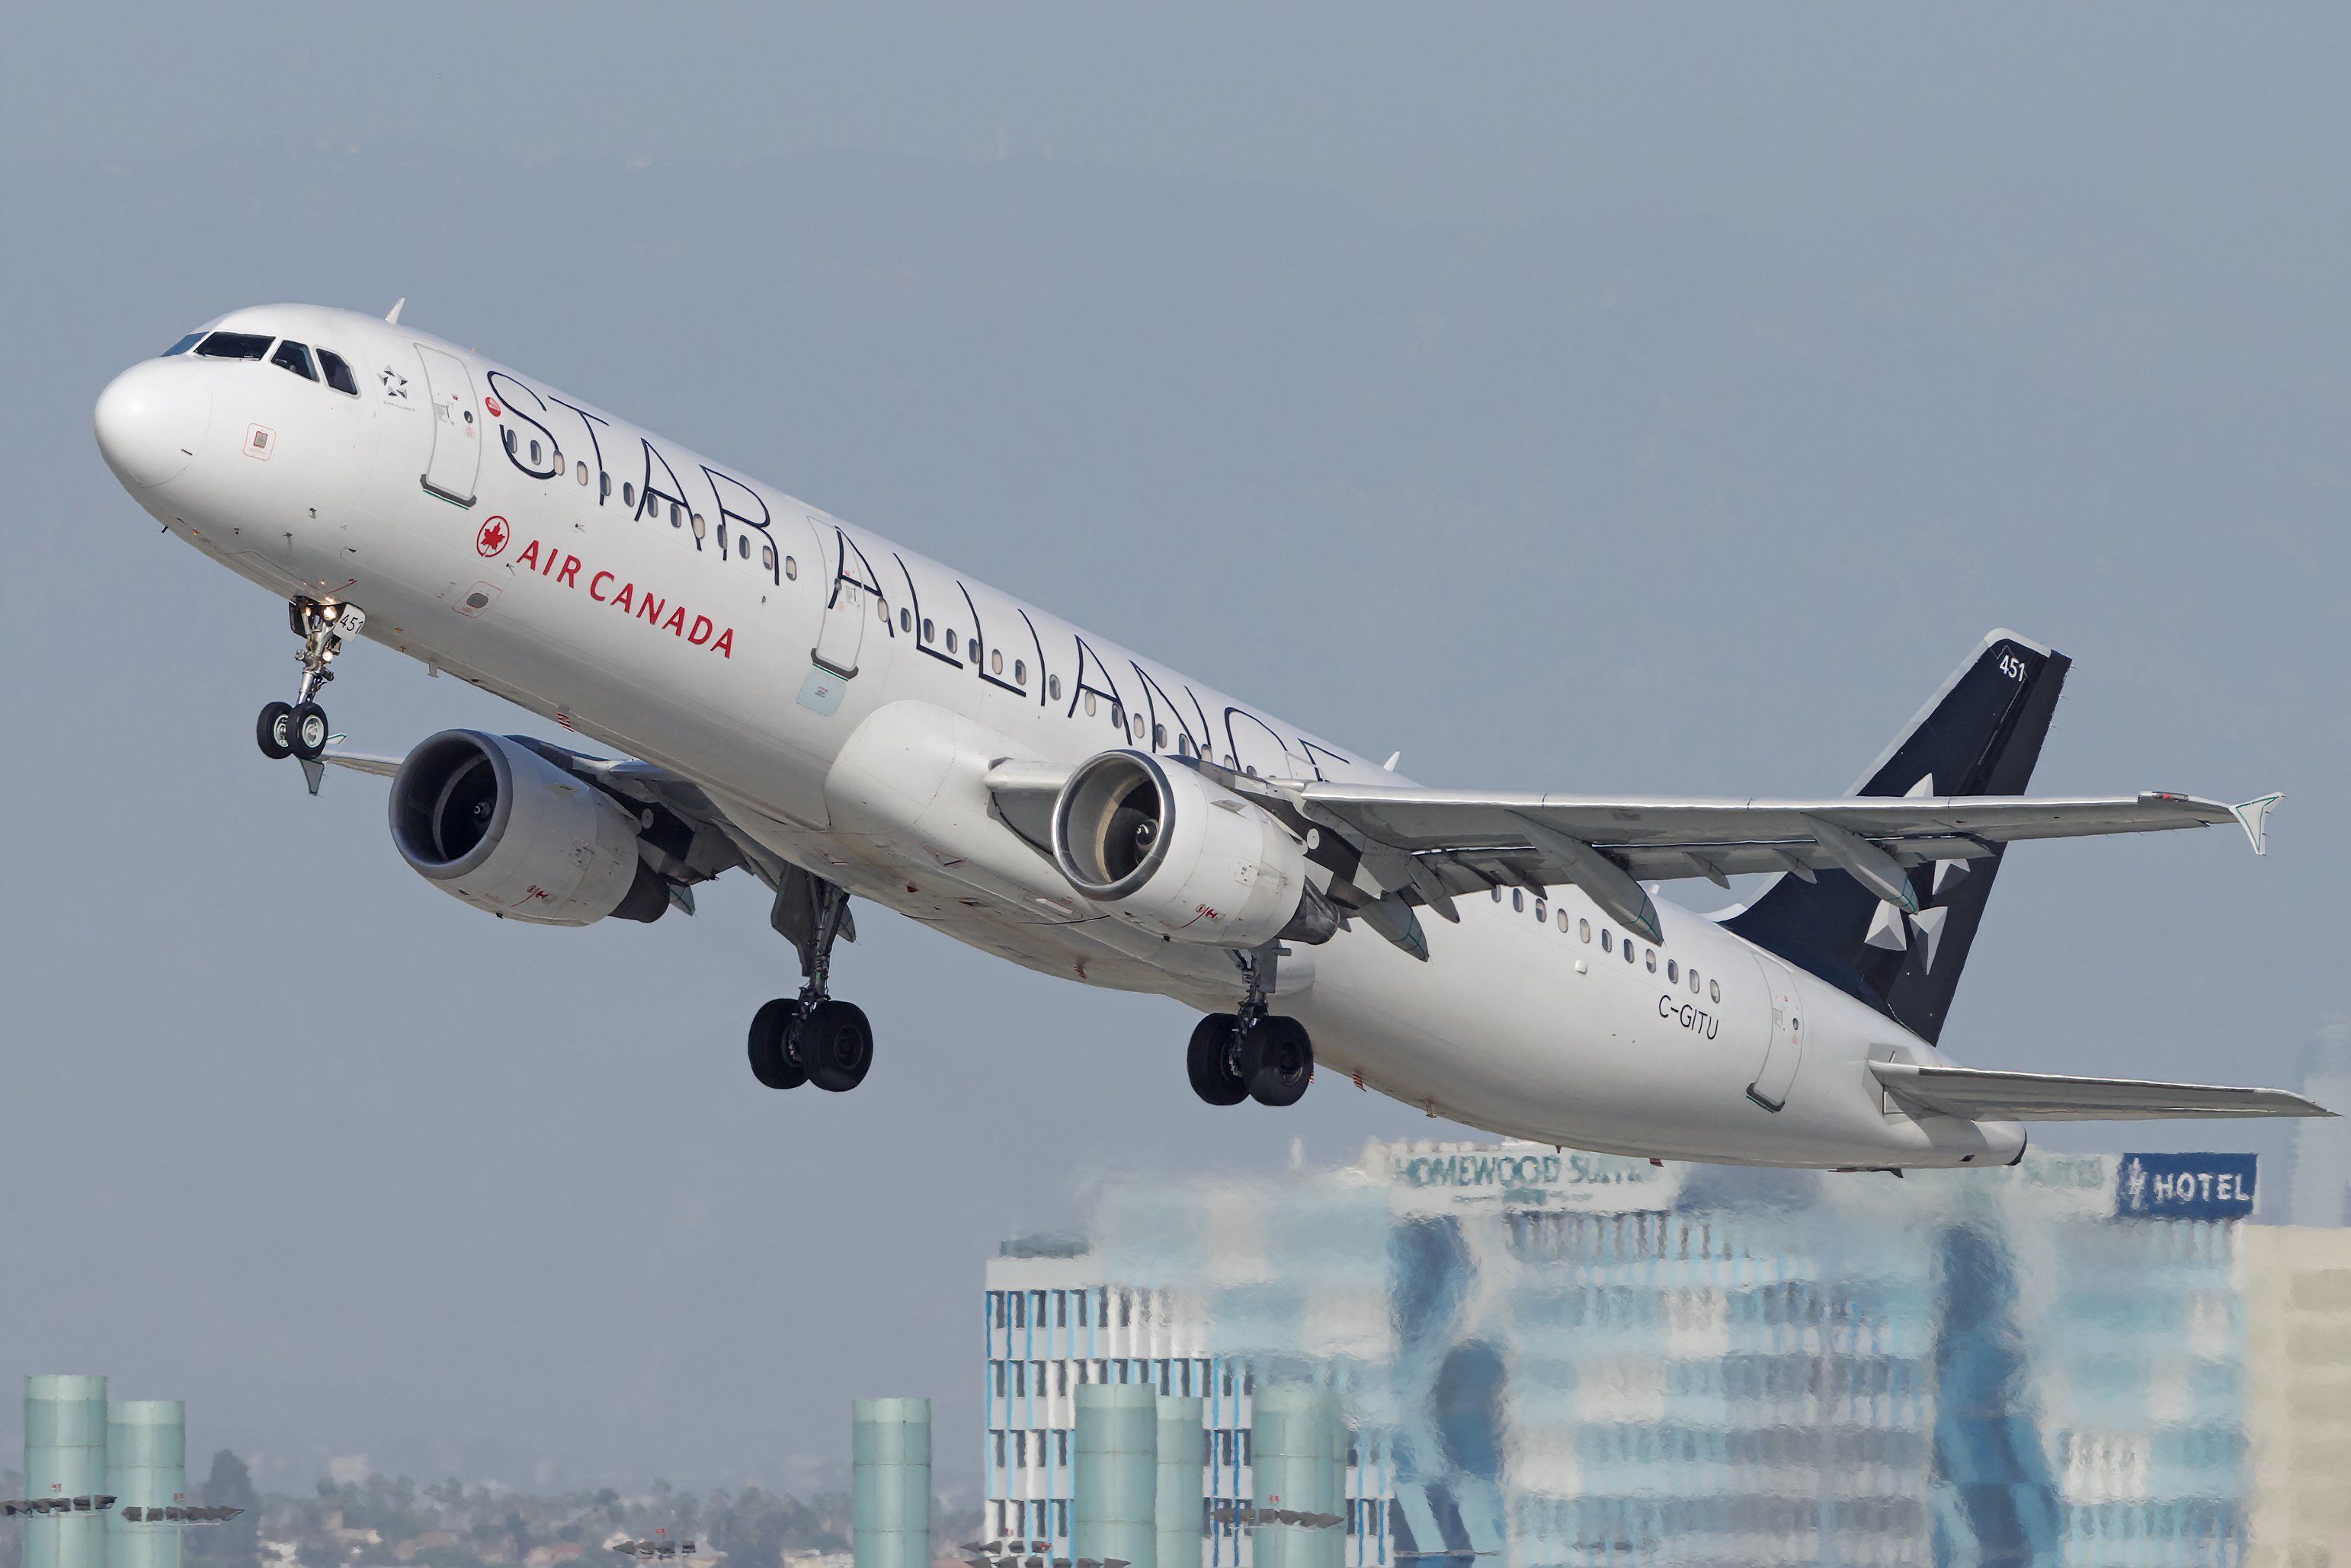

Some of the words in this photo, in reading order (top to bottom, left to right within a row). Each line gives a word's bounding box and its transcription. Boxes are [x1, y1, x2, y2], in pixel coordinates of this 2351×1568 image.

[486, 370, 780, 586] STAR
[516, 539, 582, 589] AIR
[589, 571, 735, 660] CANADA
[340, 614, 364, 635] 451
[1999, 654, 2026, 682] 451
[1658, 994, 1719, 1040] C-GITU
[1395, 1155, 1562, 1188] HOMEWOOD
[2153, 1172, 2250, 1204] HOTEL
